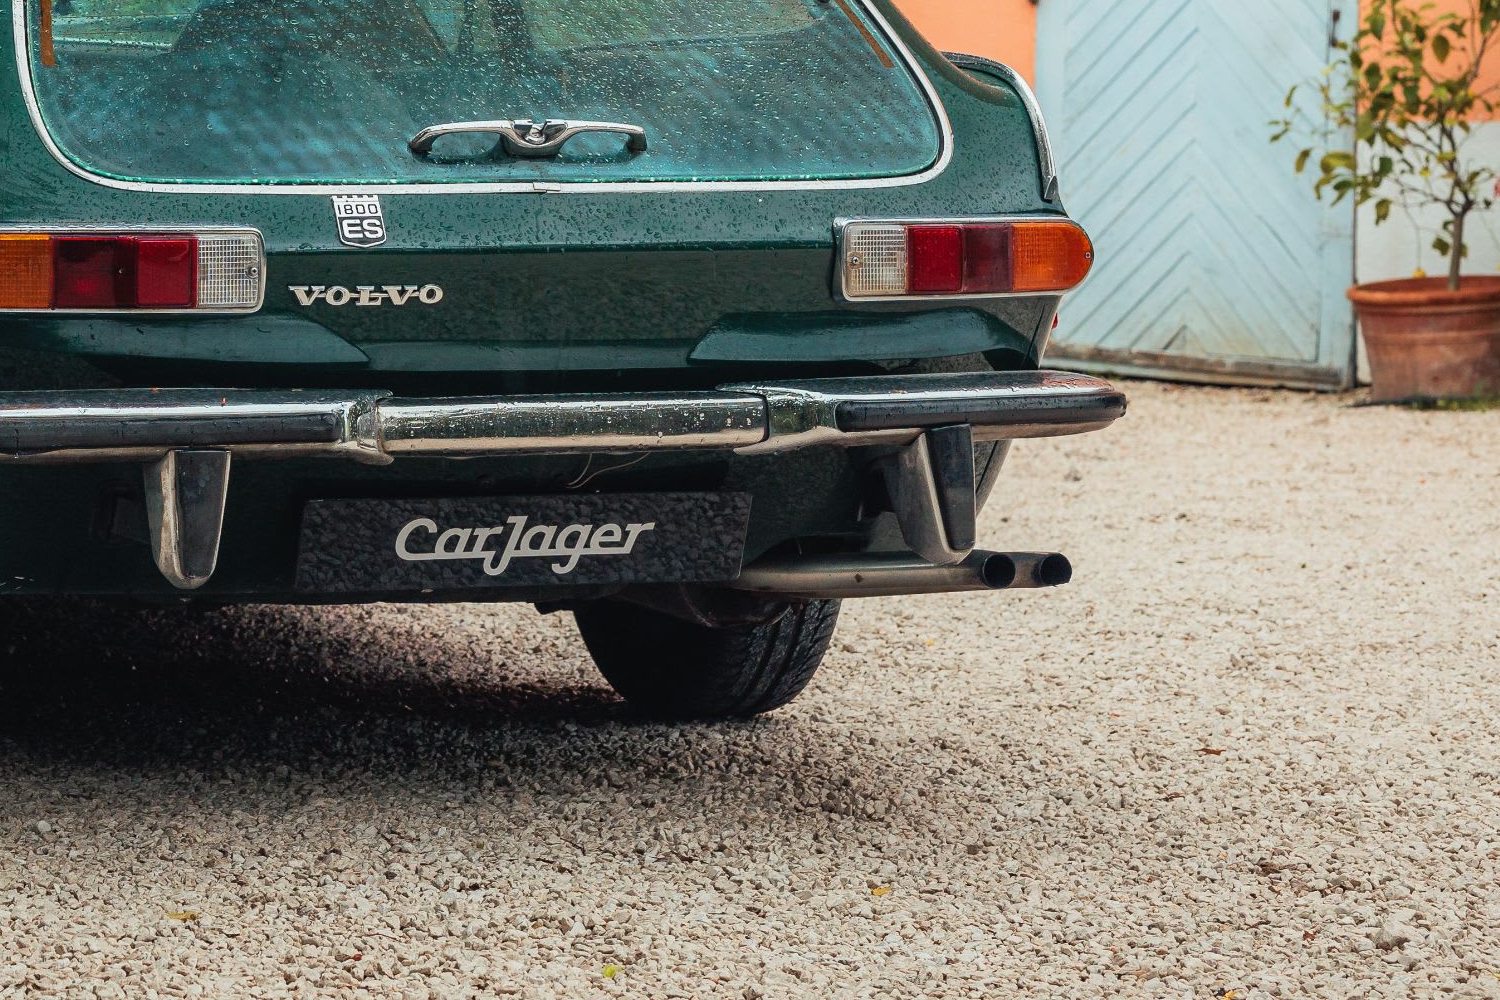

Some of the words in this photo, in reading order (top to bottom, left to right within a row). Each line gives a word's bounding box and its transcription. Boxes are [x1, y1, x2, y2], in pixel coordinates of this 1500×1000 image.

[337, 203, 379, 215] 1800
[342, 218, 384, 239] ES
[288, 283, 444, 306] VOLVO
[395, 515, 656, 577] CarJager
